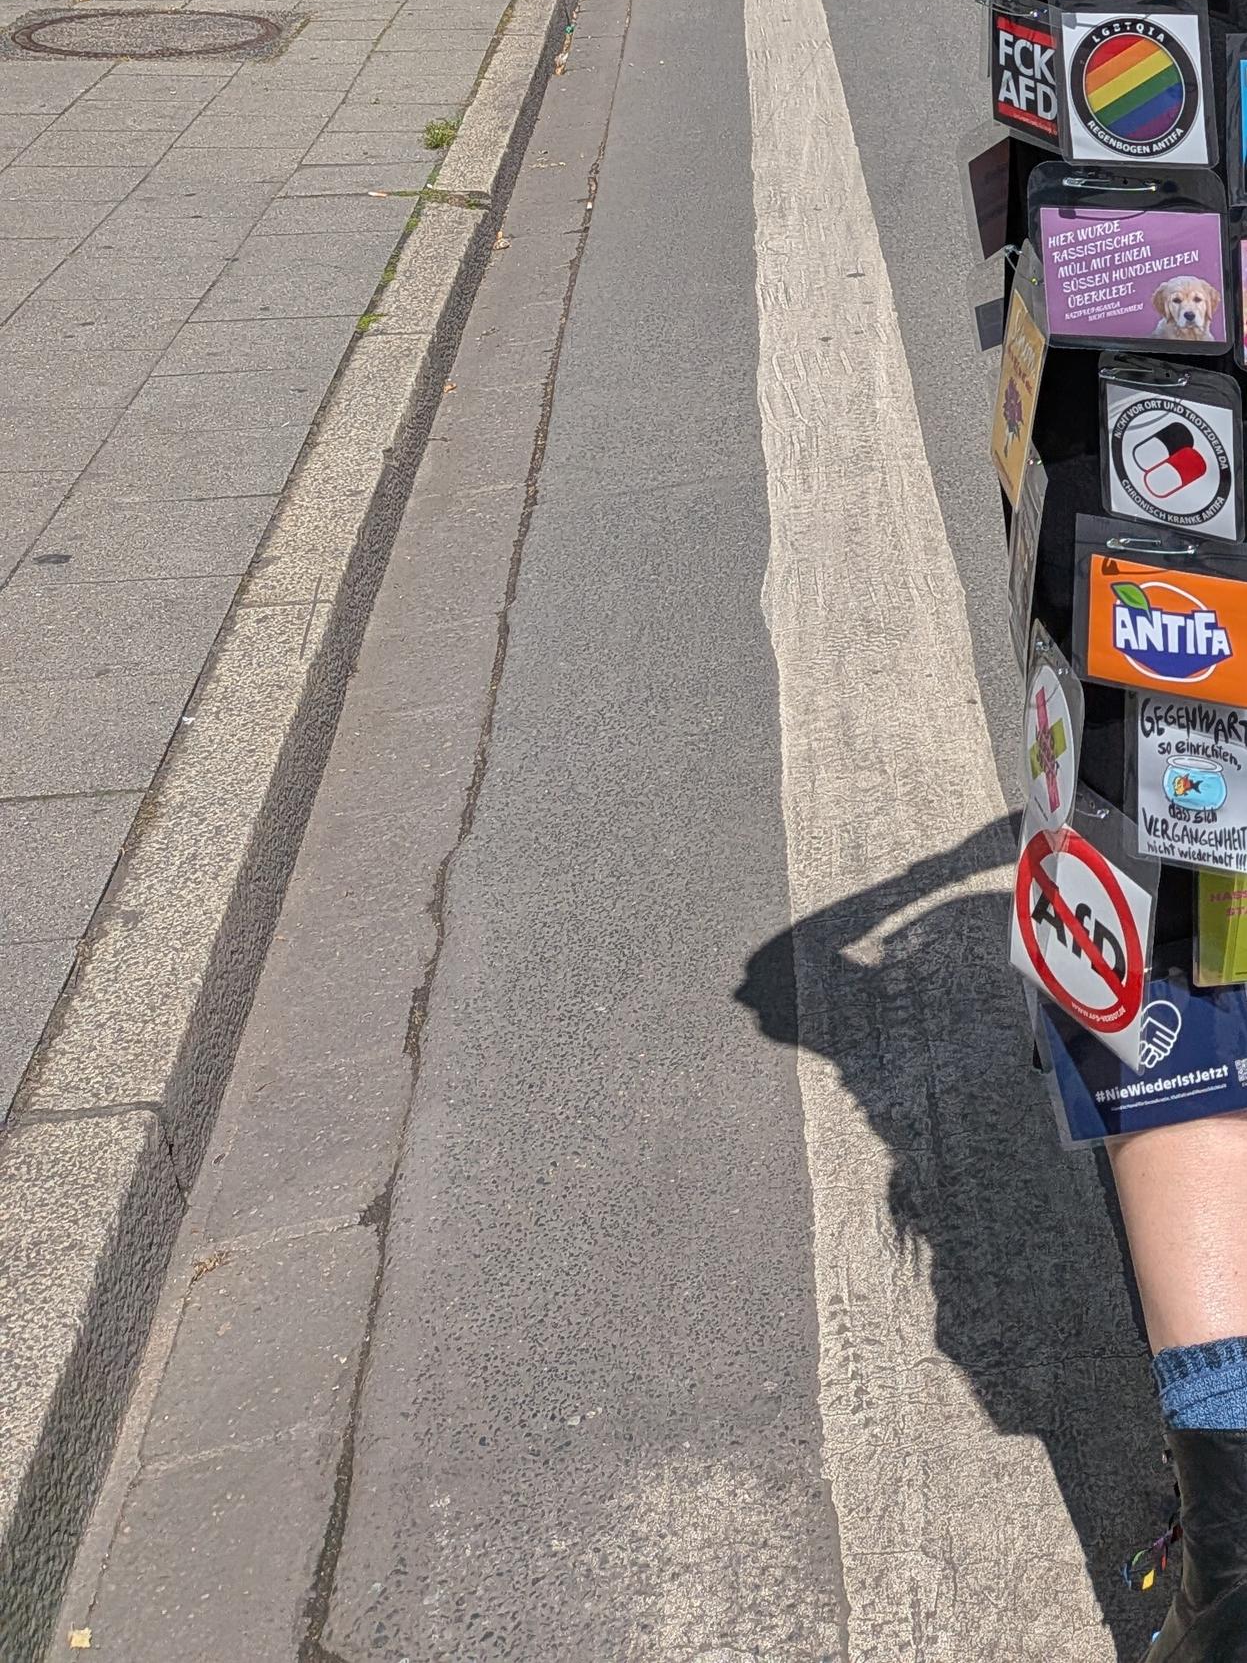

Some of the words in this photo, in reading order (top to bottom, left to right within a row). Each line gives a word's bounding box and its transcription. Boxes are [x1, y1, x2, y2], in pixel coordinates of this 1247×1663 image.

[1092, 23, 1165, 43] LGBTQIA
[999, 31, 1055, 86] FCK
[998, 70, 1057, 121] AFD
[1087, 120, 1150, 154] REGENBOGEN
[1153, 128, 1184, 153] ANTIFA
[1048, 232, 1075, 248] HIER
[1077, 220, 1120, 241] WURDE
[1053, 231, 1144, 263] RASSISTISCHER
[1057, 262, 1088, 279] MÜLL
[1090, 255, 1111, 272] MIT
[1115, 246, 1151, 264] EINEM
[1063, 273, 1109, 293] SÜSSEN
[1112, 250, 1199, 284] HUNDEWELPEN
[1122, 478, 1166, 521] CHRONISCH
[1167, 513, 1203, 524] KRANKE
[1202, 496, 1224, 521] ANTIFA
[1116, 606, 1231, 655] ANTIFA
[1158, 742, 1171, 754] so
[1176, 739, 1241, 770] einrichten,
[1142, 808, 1247, 850] VERGANGENHEIT
[1169, 800, 1190, 822] dass
[1194, 807, 1217, 823] sich
[1095, 1065, 1228, 1103] #NieWiederIstJetzt
